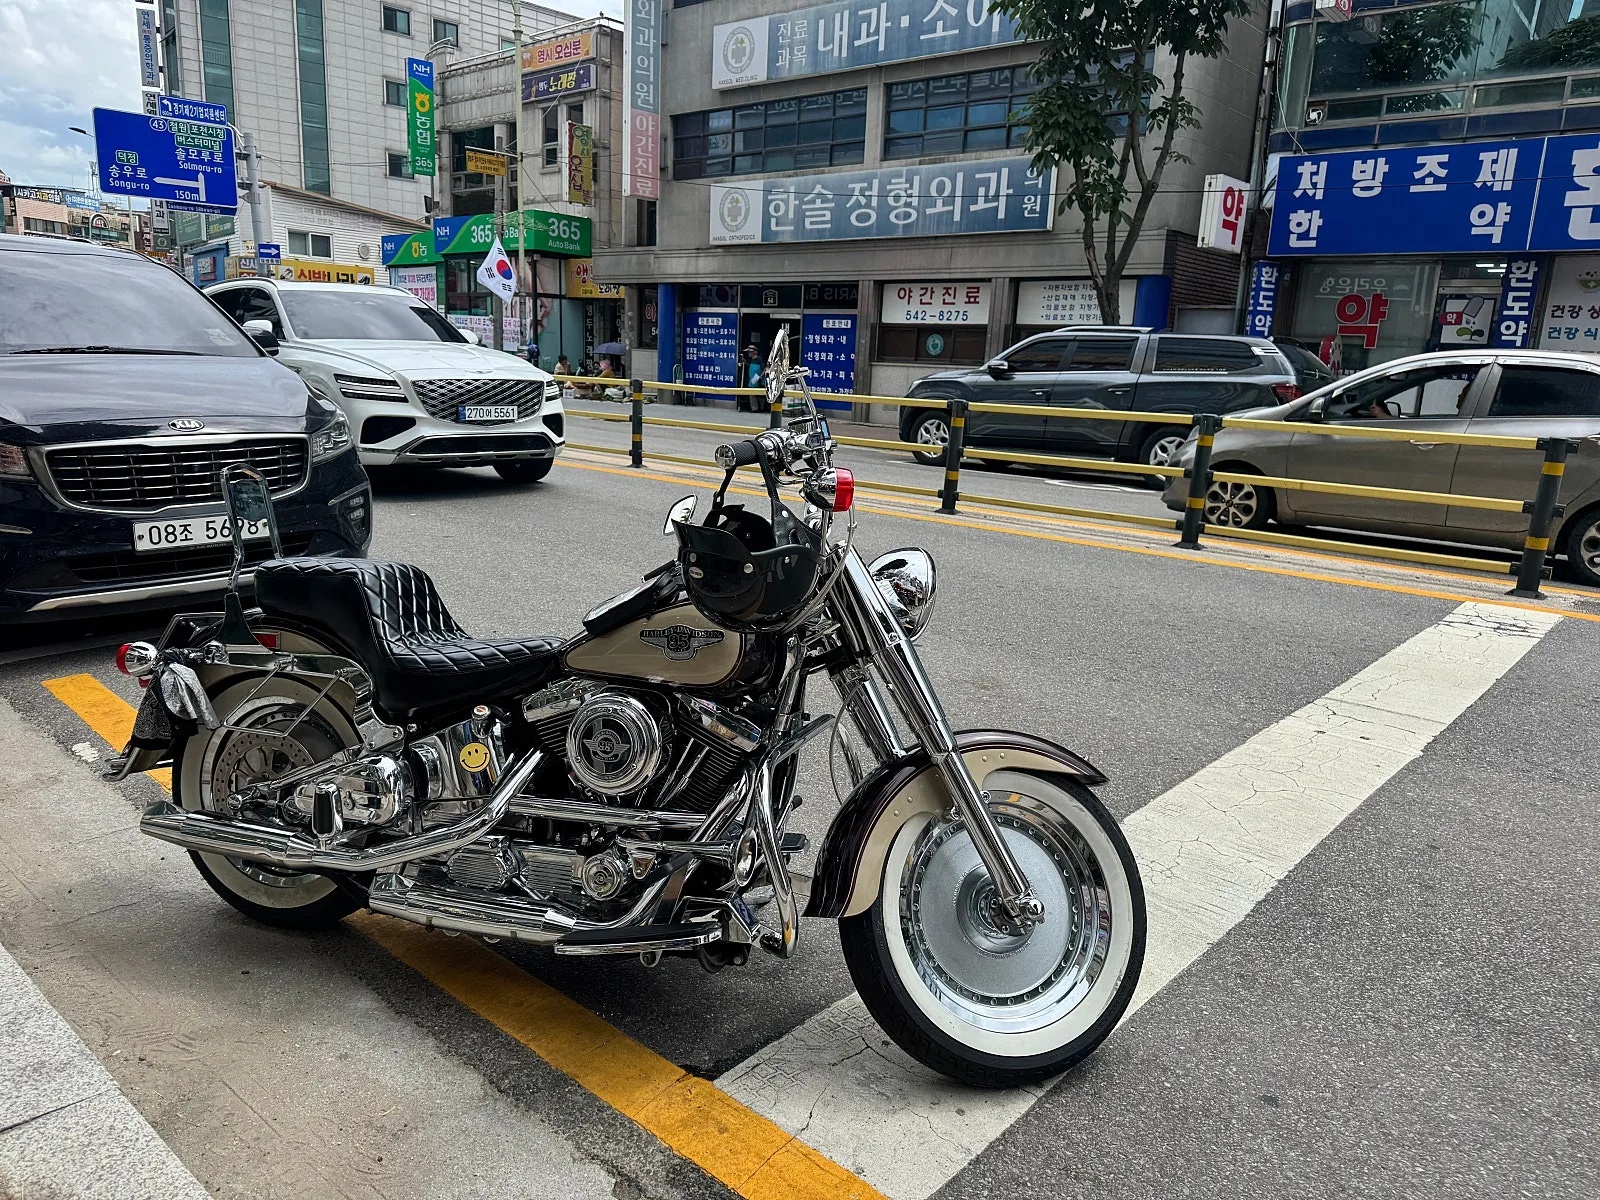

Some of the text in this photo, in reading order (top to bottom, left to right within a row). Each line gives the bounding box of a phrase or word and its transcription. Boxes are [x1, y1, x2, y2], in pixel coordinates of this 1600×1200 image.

[777, 19, 808, 43] 진료
[537, 38, 582, 64] 영시 오십분
[775, 45, 808, 69] 과목
[413, 63, 430, 74] NH
[549, 71, 577, 92] 노래짱
[152, 120, 165, 129] 43
[190, 125, 225, 139] 포천시청
[415, 111, 431, 146] 농협
[177, 135, 221, 151] 버스터미널
[118, 152, 136, 163] 덕정
[175, 148, 224, 163] 솔모루로
[415, 156, 433, 168] 365
[634, 115, 656, 197] 야간진료
[108, 165, 148, 178] 송우로
[178, 161, 222, 174] Solmoru-ro
[1292, 148, 1519, 200] 처방조제
[109, 178, 150, 190] Songu-ro
[16, 187, 61, 203] 시카고치과의원
[175, 190, 199, 201] 150m
[767, 183, 836, 232] 한솔
[845, 167, 1014, 228] 정형외과
[1022, 167, 1043, 218] 의원
[154, 199, 166, 219] 내과
[1222, 186, 1244, 245] 약
[436, 225, 450, 236] NH
[471, 224, 492, 243] 365
[509, 227, 528, 238] Bak
[548, 217, 581, 241] 365
[383, 242, 395, 251] NH
[548, 239, 581, 251] Auto Bank
[1081, 283, 1097, 291] 지정
[897, 286, 980, 306] 야간진료
[1254, 266, 1279, 336] 환도약
[1500, 259, 1539, 347] 환도약
[905, 310, 969, 322] 542-8275
[1446, 312, 1457, 324] 약
[1550, 304, 1583, 319] 건강
[1335, 292, 1390, 349] 약
[808, 334, 834, 344] 정형외과
[1547, 326, 1599, 341] 건강 식
[807, 351, 833, 361] 신경외과
[466, 407, 516, 418] 270어 5561
[175, 419, 201, 429] KIA
[148, 523, 194, 546] 08조
[642, 625, 723, 638] HARLEY-DAVIDSON
[668, 633, 690, 649] 95
[599, 740, 613, 751] 95
